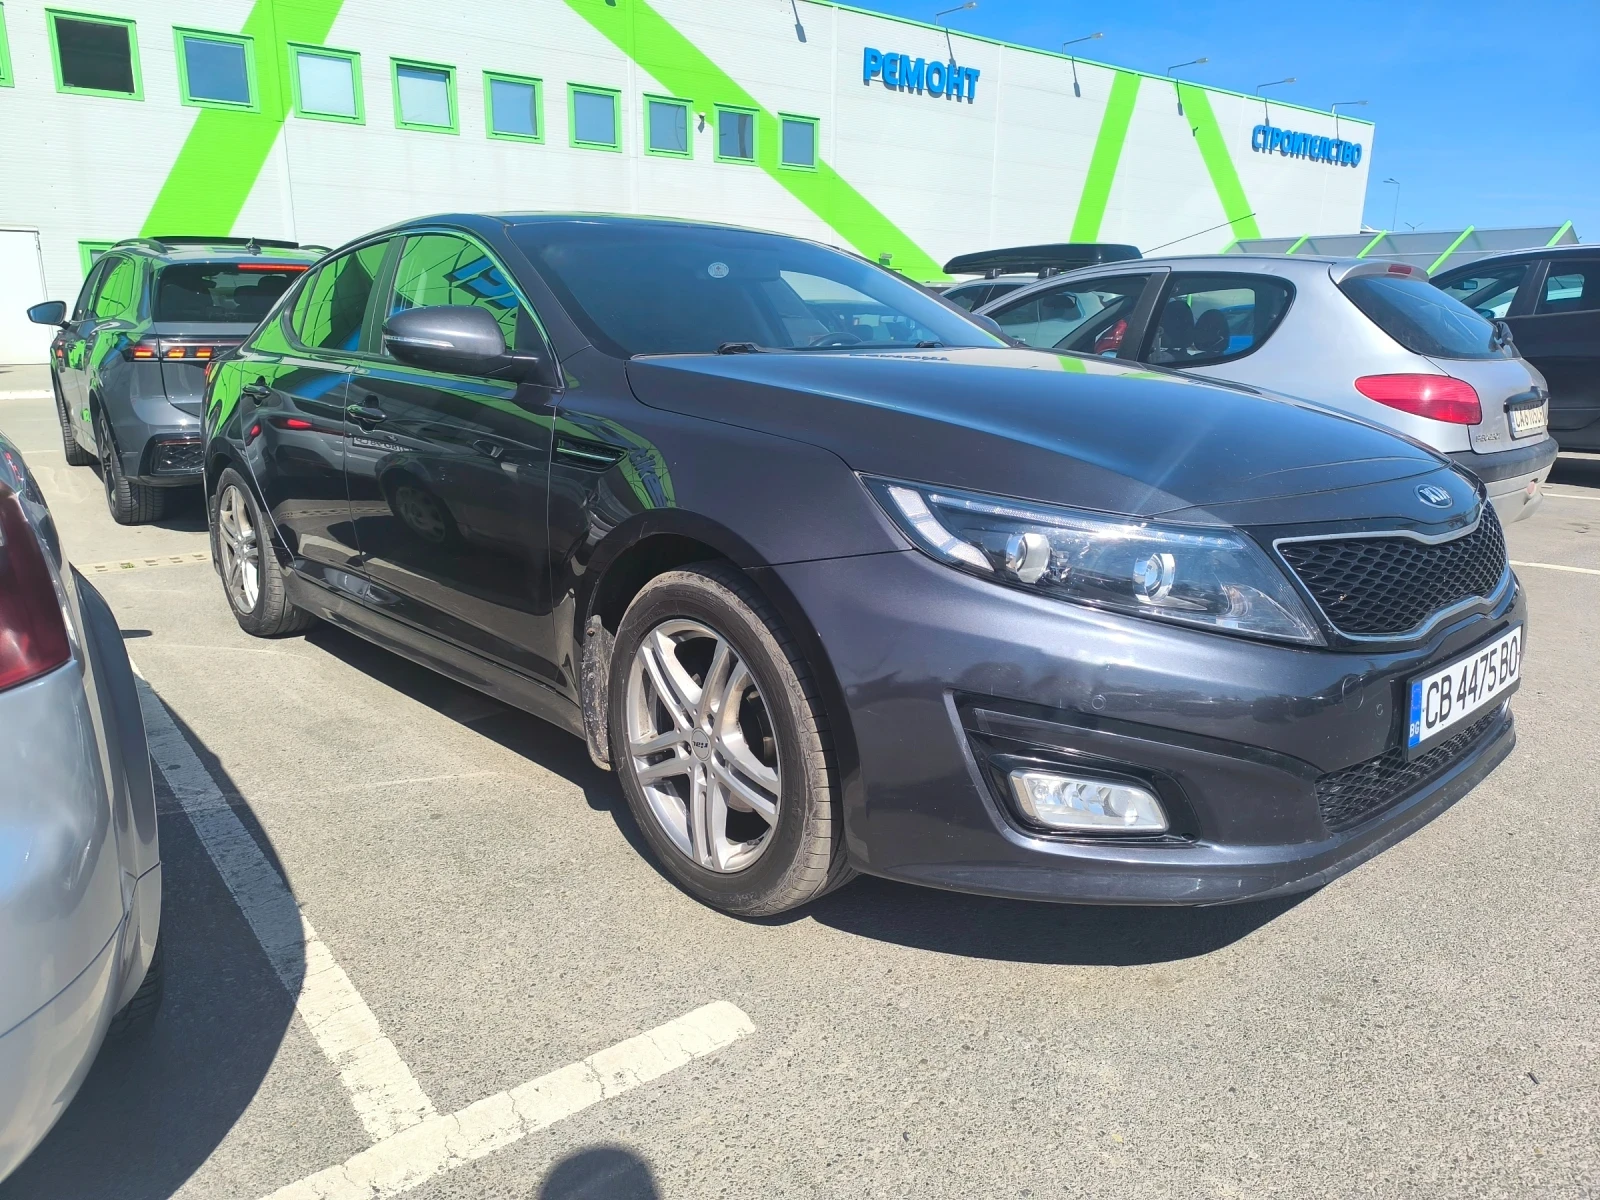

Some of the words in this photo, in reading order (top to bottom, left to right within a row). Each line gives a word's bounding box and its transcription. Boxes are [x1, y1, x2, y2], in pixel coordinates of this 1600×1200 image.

[863, 47, 980, 100] РЕМОНТ
[1252, 124, 1362, 166] СТРОИТЕЛСТВО
[1425, 674, 1452, 729] CB
[1456, 647, 1498, 710] 4475
[1499, 635, 1518, 686] BO
[1409, 721, 1420, 738] BG
